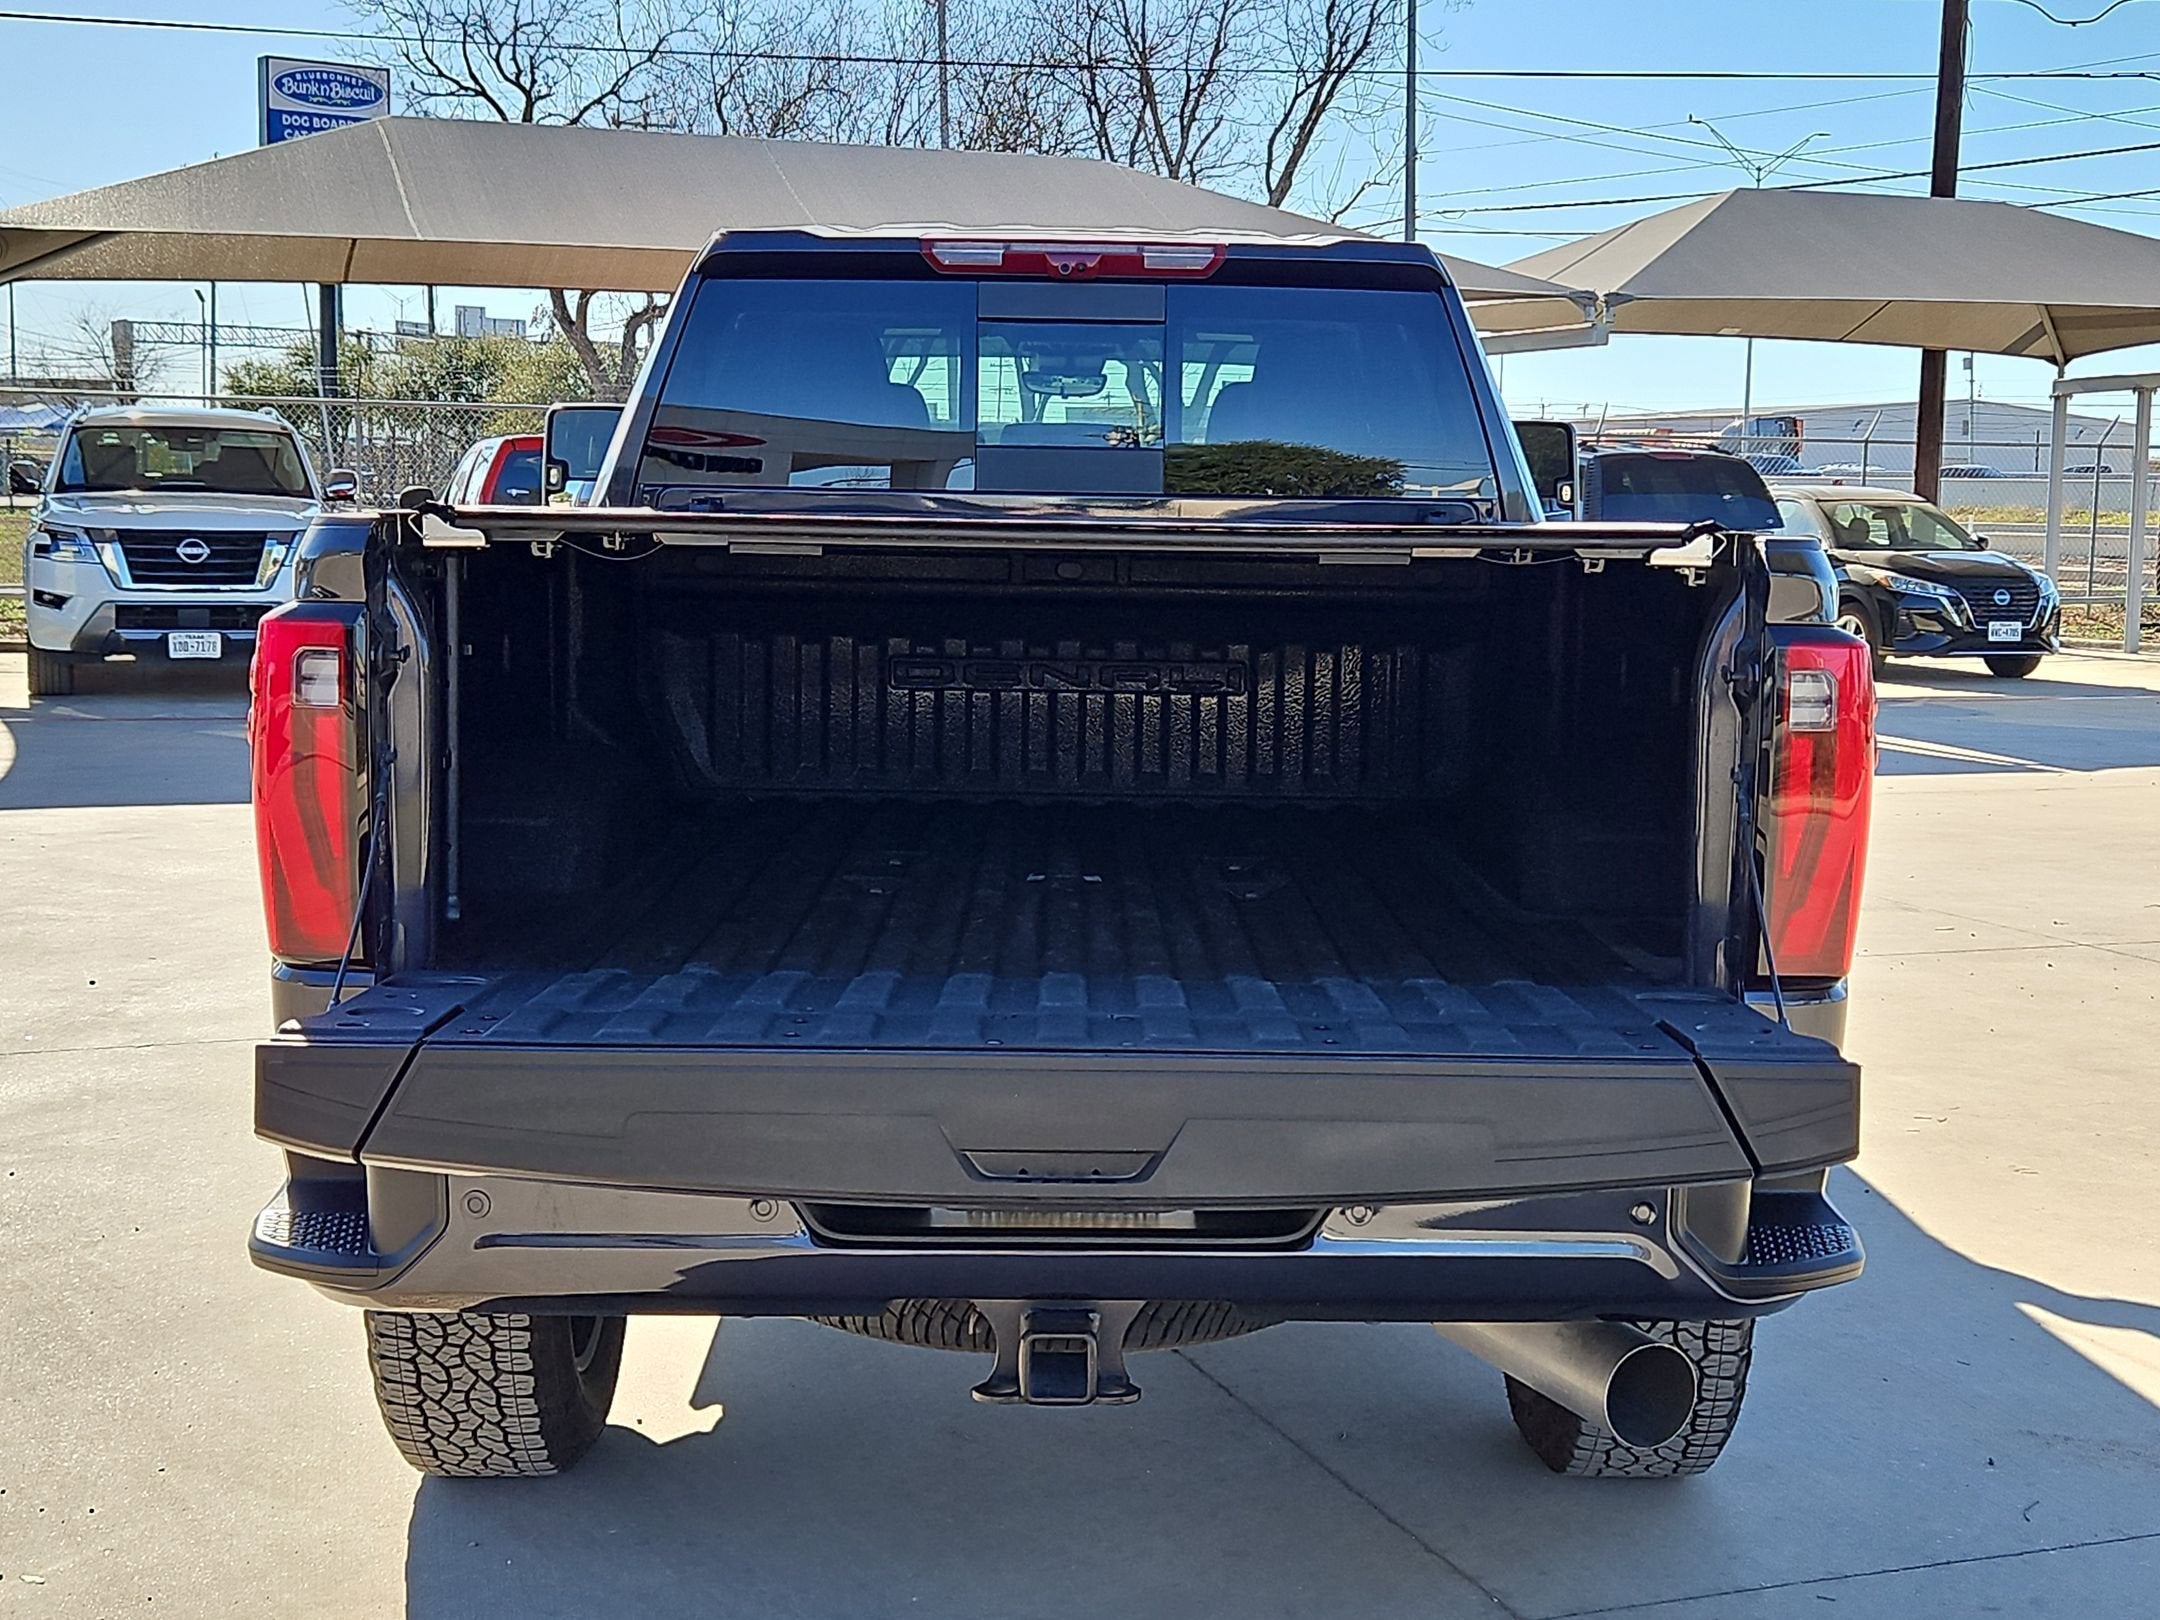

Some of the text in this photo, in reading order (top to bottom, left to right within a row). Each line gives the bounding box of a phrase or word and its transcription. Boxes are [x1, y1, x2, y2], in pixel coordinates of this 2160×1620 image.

[295, 72, 363, 87] BLUEBONNET
[282, 114, 310, 127] DOG
[890, 658, 1248, 697] DENALI
